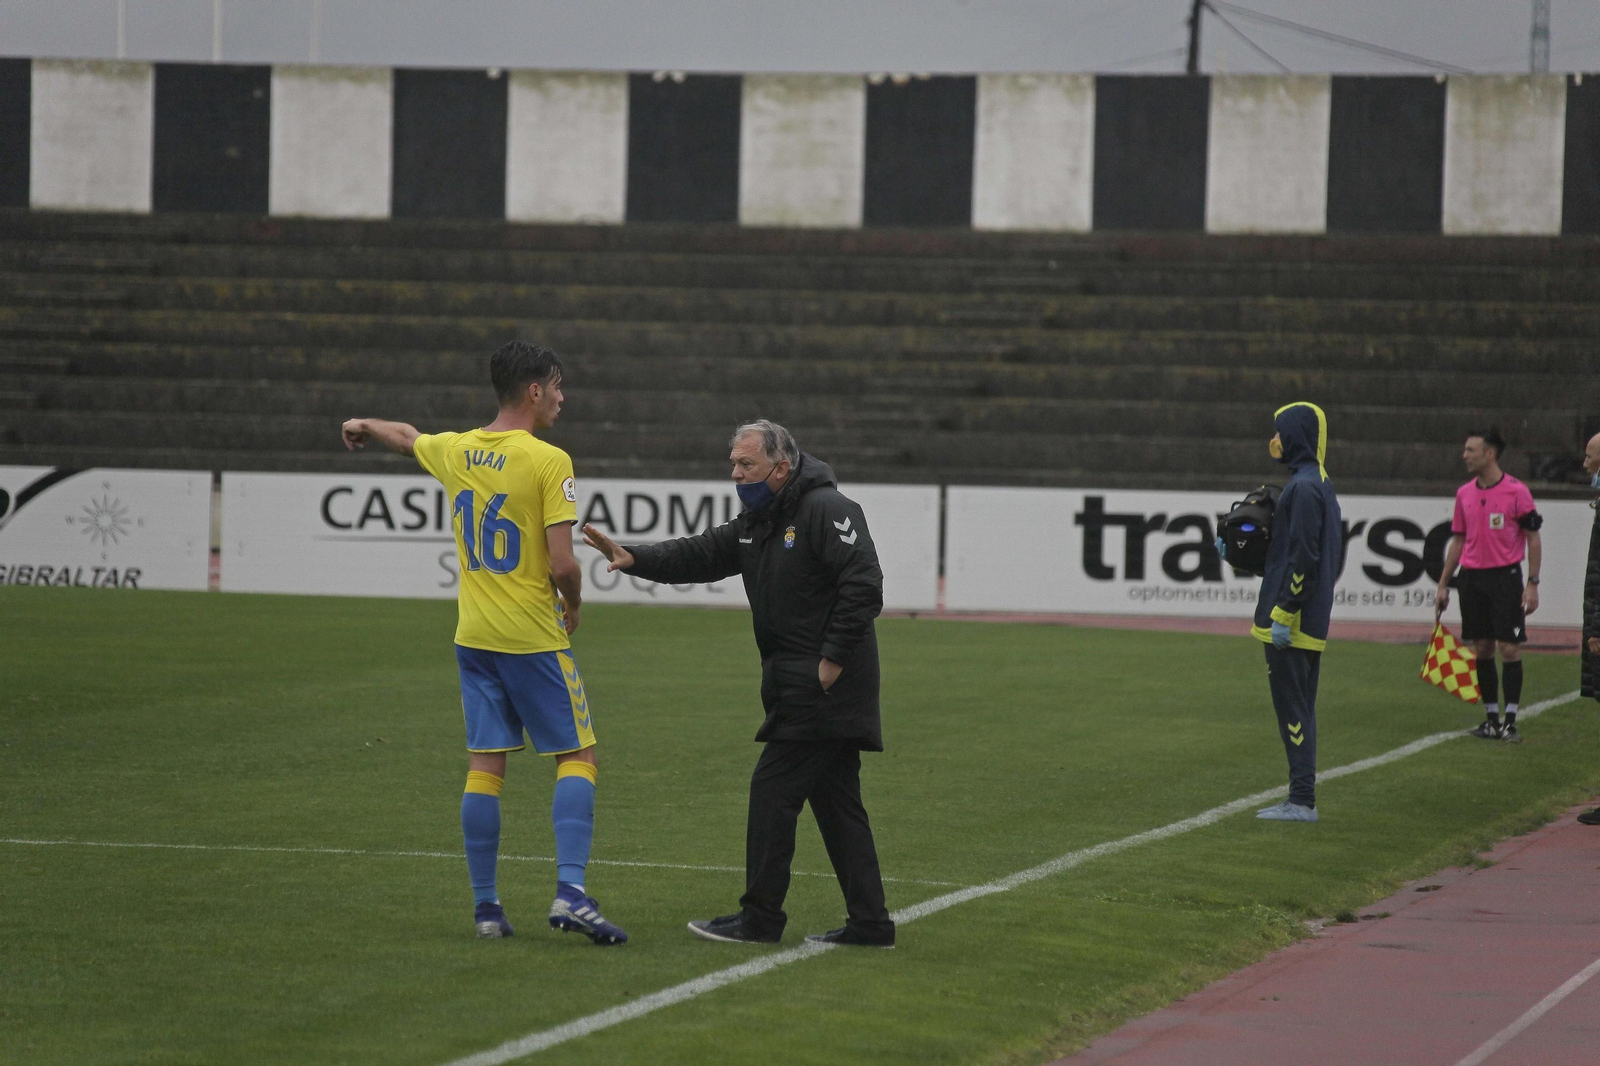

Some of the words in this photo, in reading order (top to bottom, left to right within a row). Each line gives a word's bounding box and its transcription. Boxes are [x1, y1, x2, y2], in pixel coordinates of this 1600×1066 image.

[464, 450, 506, 472] JUAN
[321, 486, 454, 532] CASI
[579, 492, 743, 536] ADMI
[453, 489, 521, 575] 16
[1074, 495, 1458, 586] trars
[1334, 588, 1396, 606] desde
[1403, 588, 1437, 607] 195
